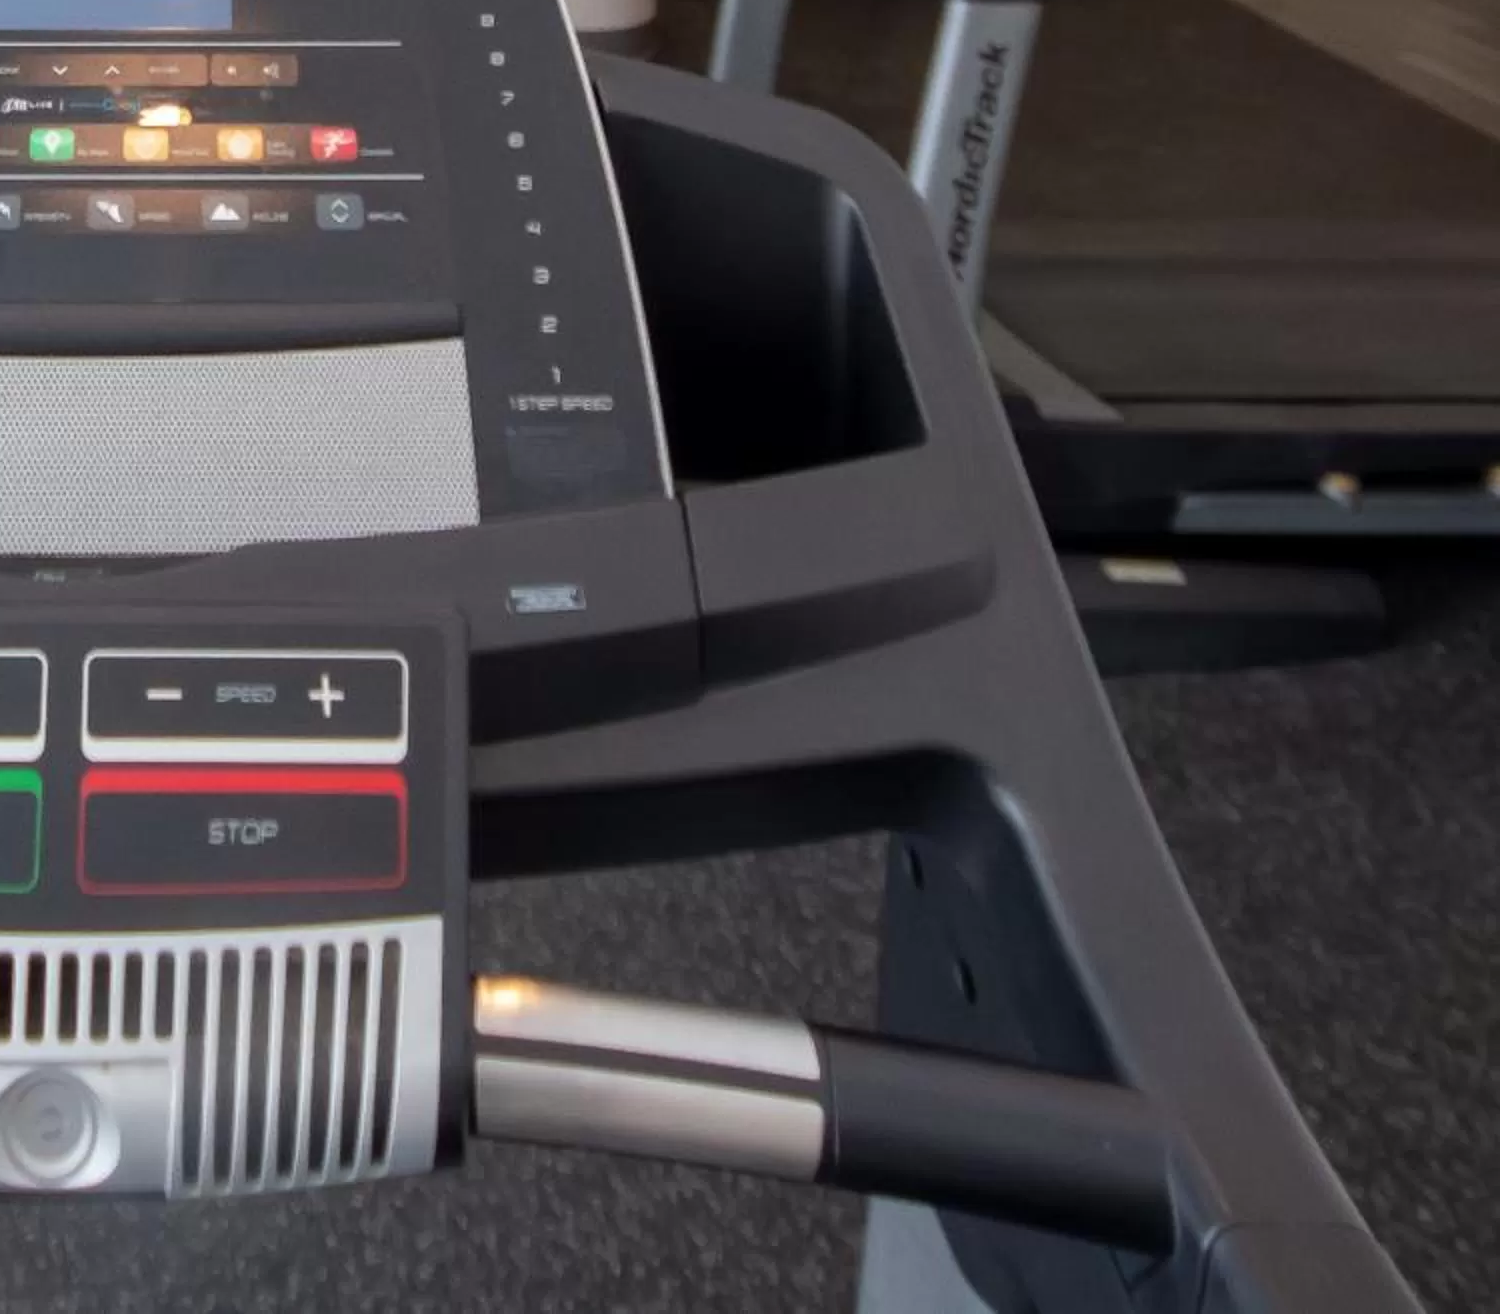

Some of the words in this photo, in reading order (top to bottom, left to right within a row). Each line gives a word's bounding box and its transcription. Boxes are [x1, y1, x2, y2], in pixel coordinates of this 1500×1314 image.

[501, 90, 515, 106] 7
[216, 683, 277, 703] SPEED
[207, 818, 279, 846] STOP
